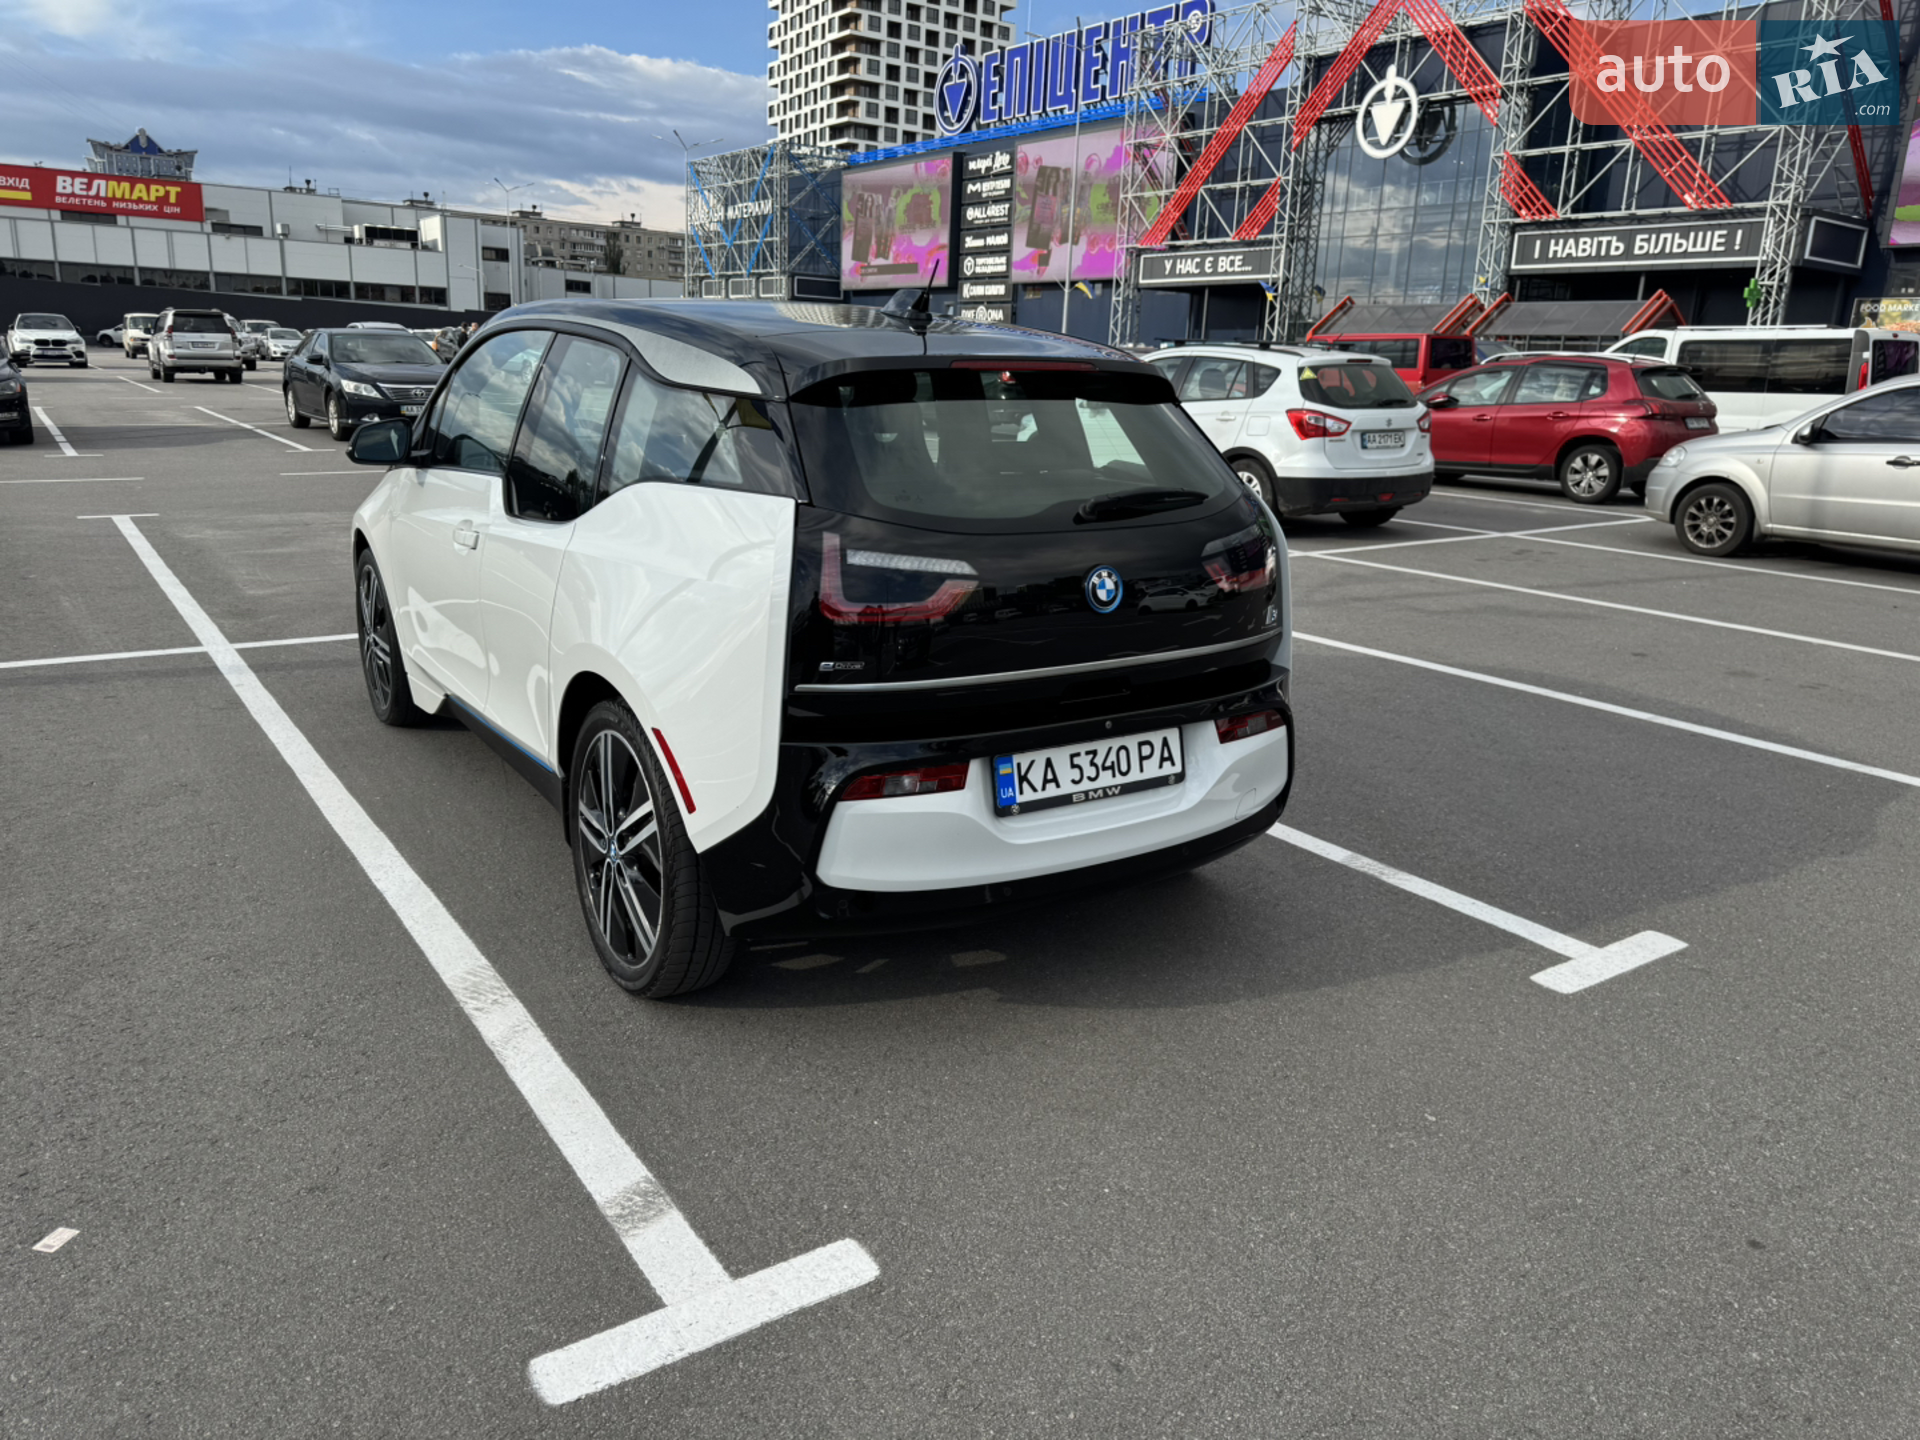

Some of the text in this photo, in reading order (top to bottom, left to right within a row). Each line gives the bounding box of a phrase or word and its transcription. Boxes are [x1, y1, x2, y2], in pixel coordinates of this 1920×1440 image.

[980, 0, 1212, 124] ЕПІЦЕНТР
[0, 176, 30, 189] ВХІД
[56, 175, 181, 203] ВЕЛМАРТ
[55, 195, 181, 214] ВЕЛЕТЕНЬ НИЗЬКИХ ЦІН
[1548, 235, 1625, 259] НАВІТЬ
[1633, 230, 1728, 255] БІЛЬШЕ
[1164, 254, 1253, 276] У НАС Є ВСЕ...
[1860, 303, 1886, 312] FOOD
[1016, 736, 1176, 796] KA 5340 PA
[1001, 787, 1015, 799] UA
[1072, 786, 1121, 803] BMW
